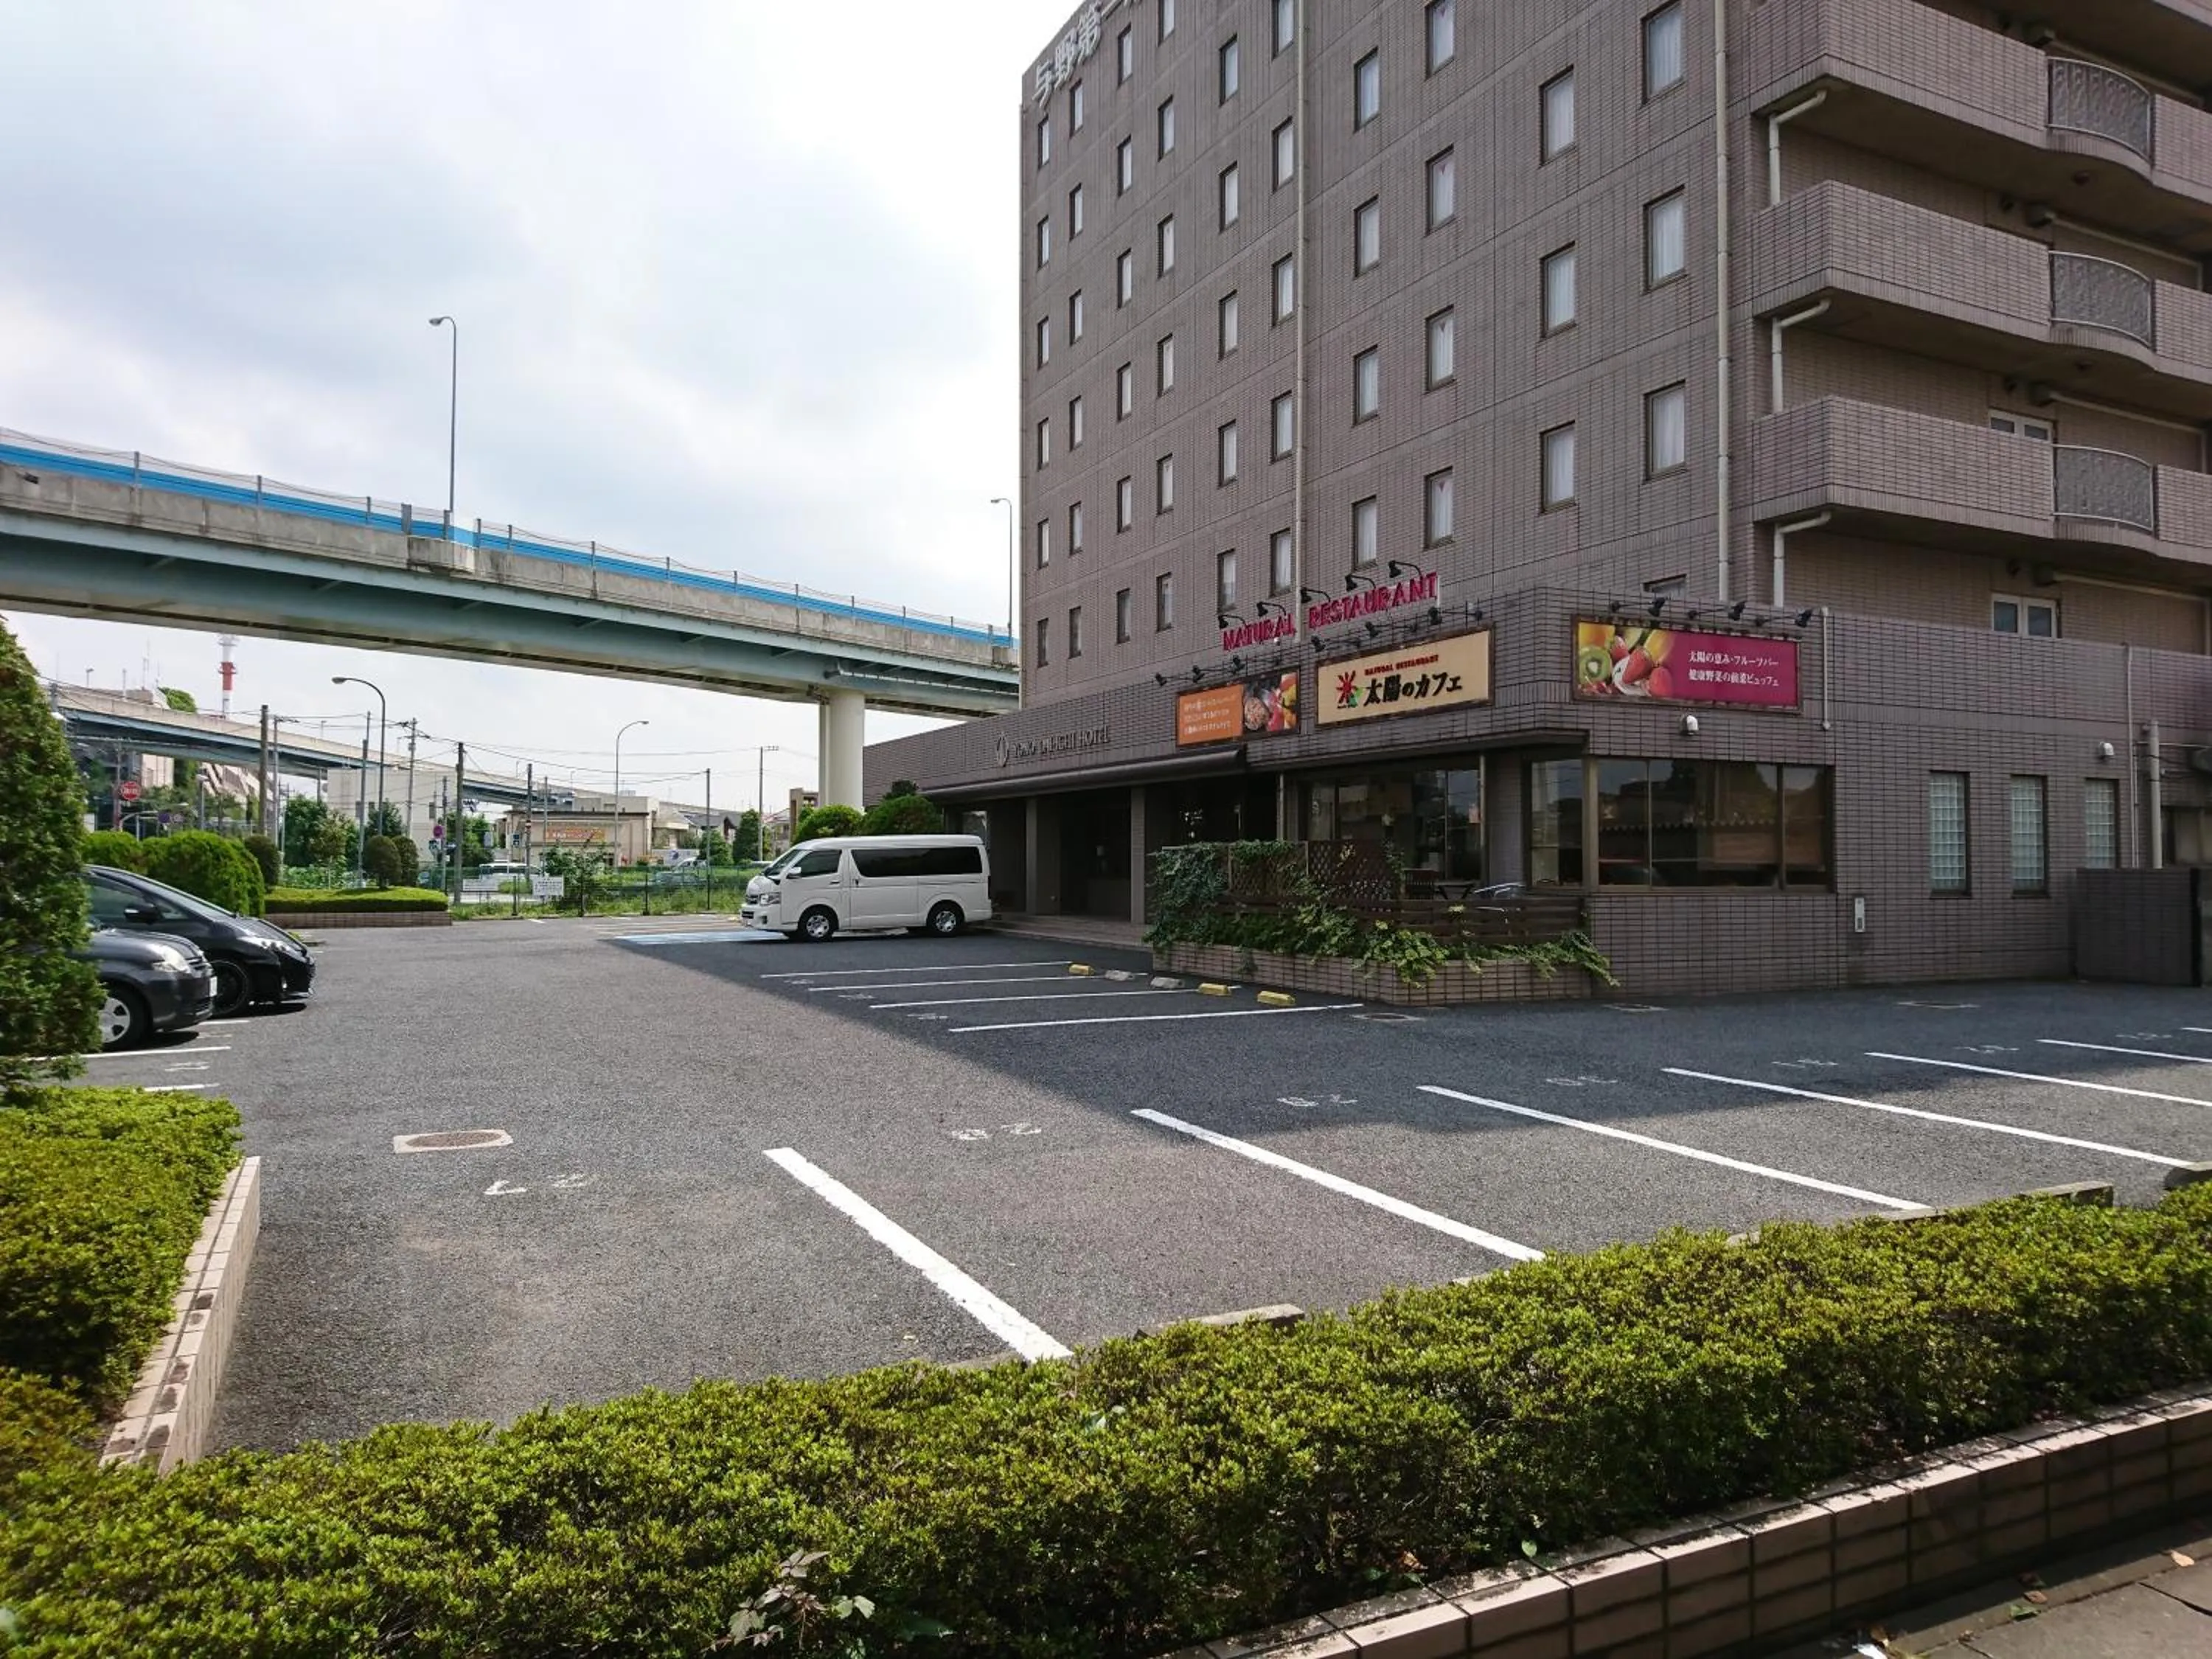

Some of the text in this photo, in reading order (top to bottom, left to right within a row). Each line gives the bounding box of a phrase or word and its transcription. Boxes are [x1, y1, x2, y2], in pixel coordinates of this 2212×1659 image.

[1032, 0, 1143, 108] 与野第一
[1222, 572, 1438, 651] NATURAL RESTAURANT
[1363, 672, 1463, 707] 太陽のカフェ
